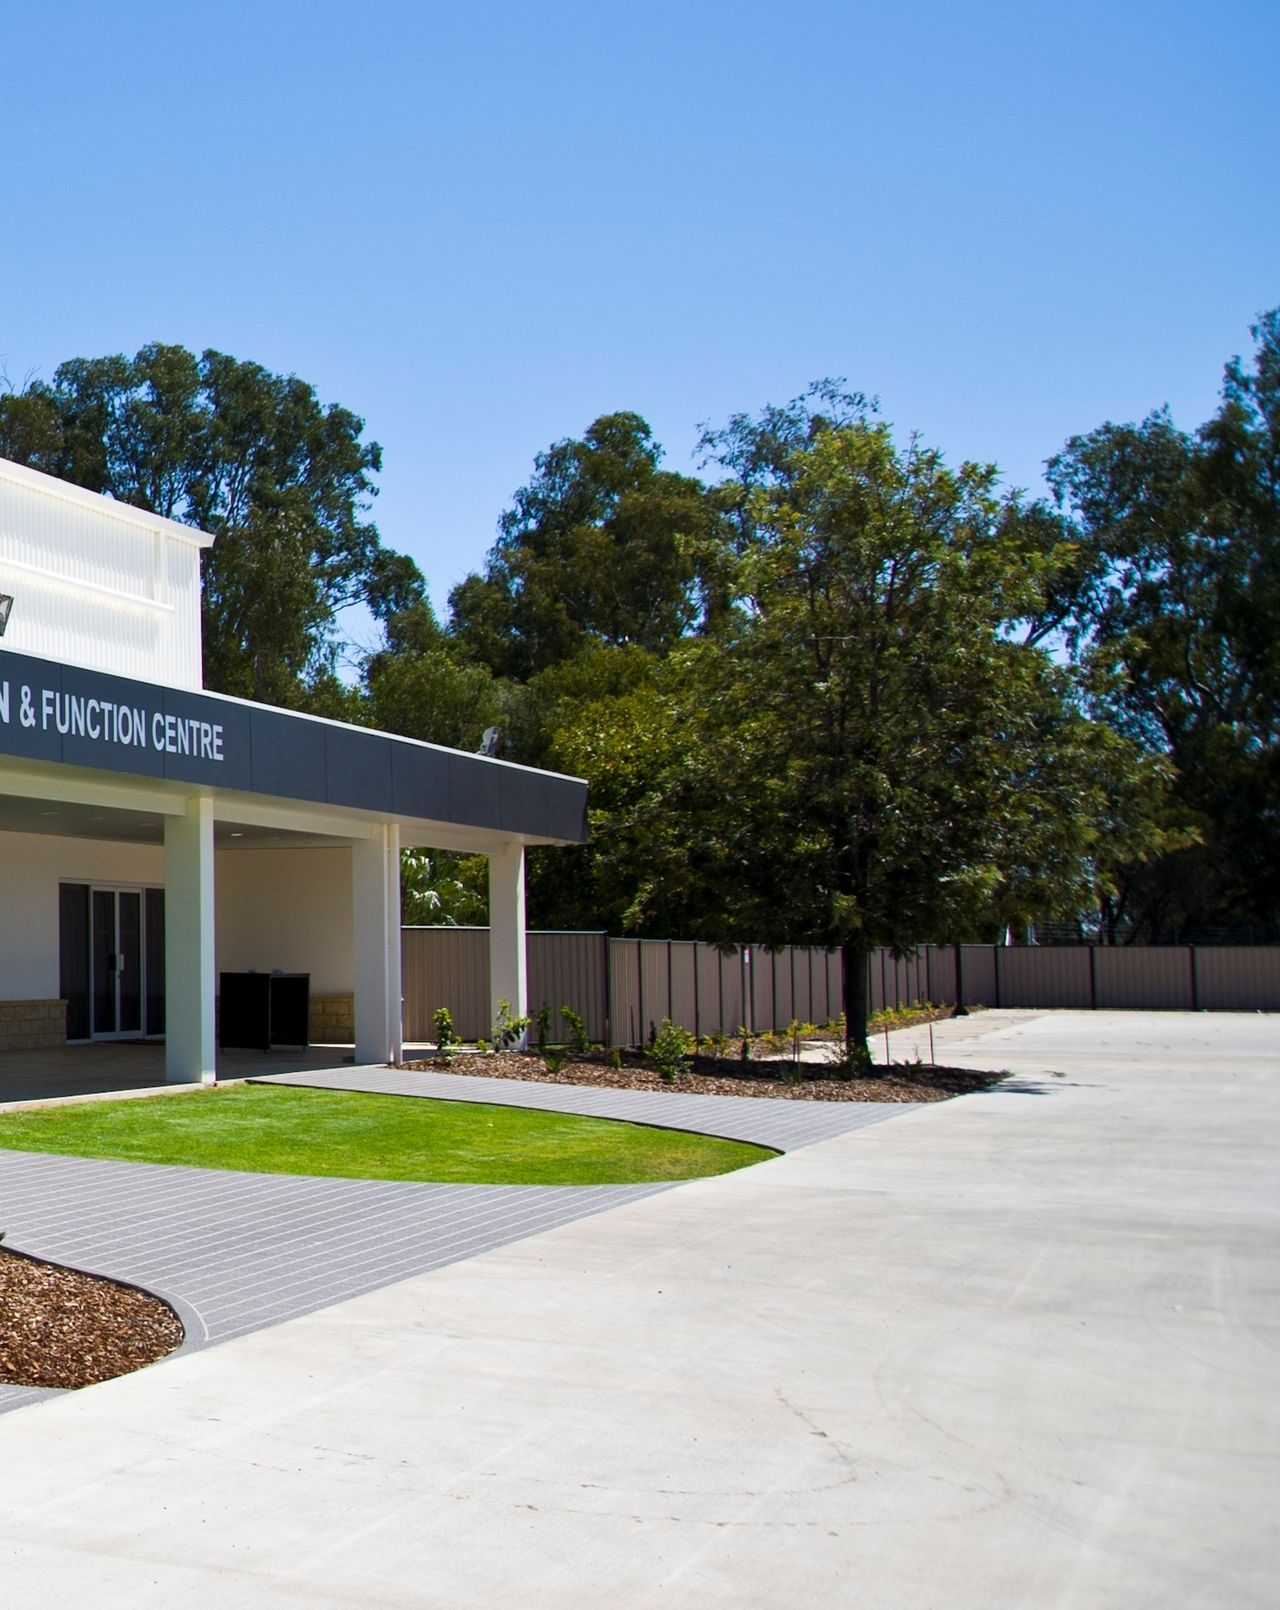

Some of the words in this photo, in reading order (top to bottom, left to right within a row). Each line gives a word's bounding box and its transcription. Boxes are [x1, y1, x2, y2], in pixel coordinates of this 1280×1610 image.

[19, 685, 36, 728] &
[42, 690, 146, 747] FUNCTION
[152, 712, 224, 762] CENTRE
